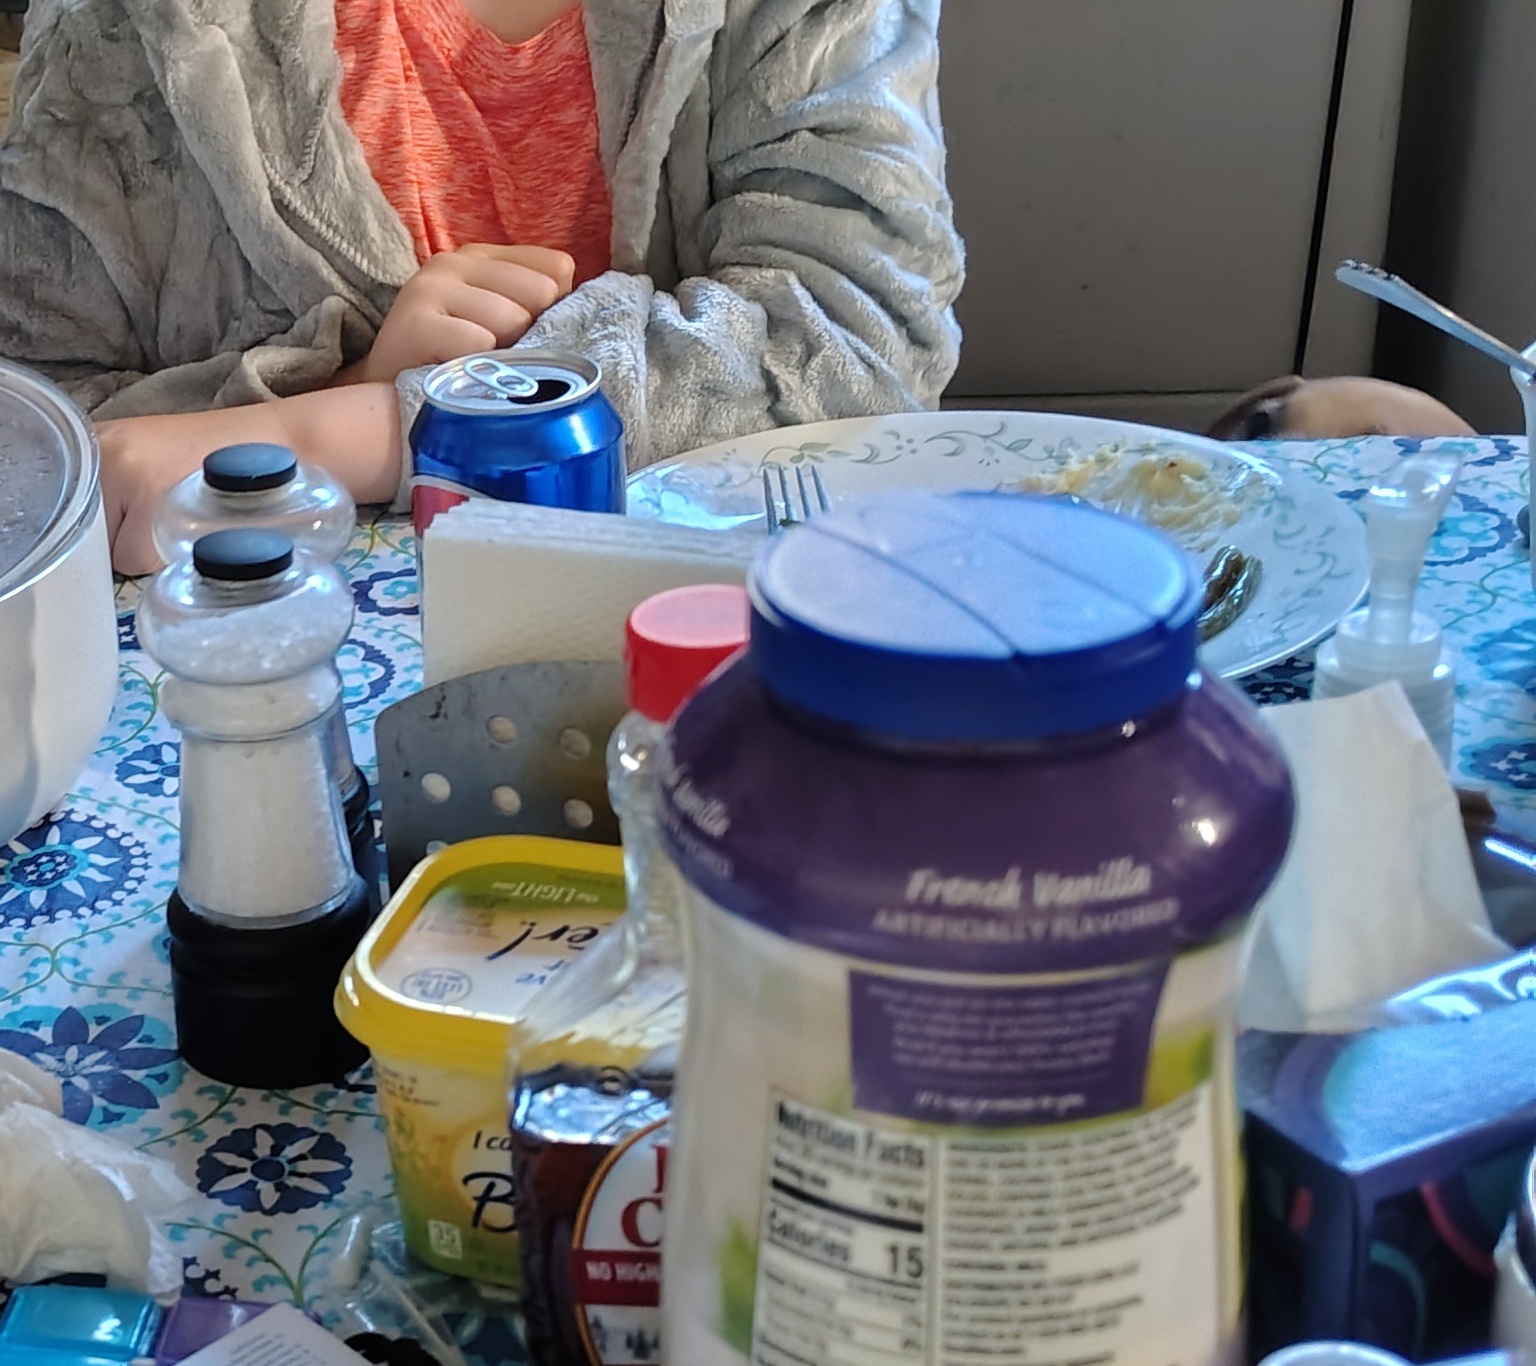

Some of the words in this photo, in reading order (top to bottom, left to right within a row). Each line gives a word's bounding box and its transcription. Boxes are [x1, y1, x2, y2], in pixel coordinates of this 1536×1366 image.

[511, 880, 577, 904] LIGHT
[907, 867, 1023, 908] French
[1031, 855, 1154, 906] Vanilla
[866, 1132, 925, 1169] Facts
[586, 1260, 612, 1282] NO
[888, 1244, 925, 1279] 15
